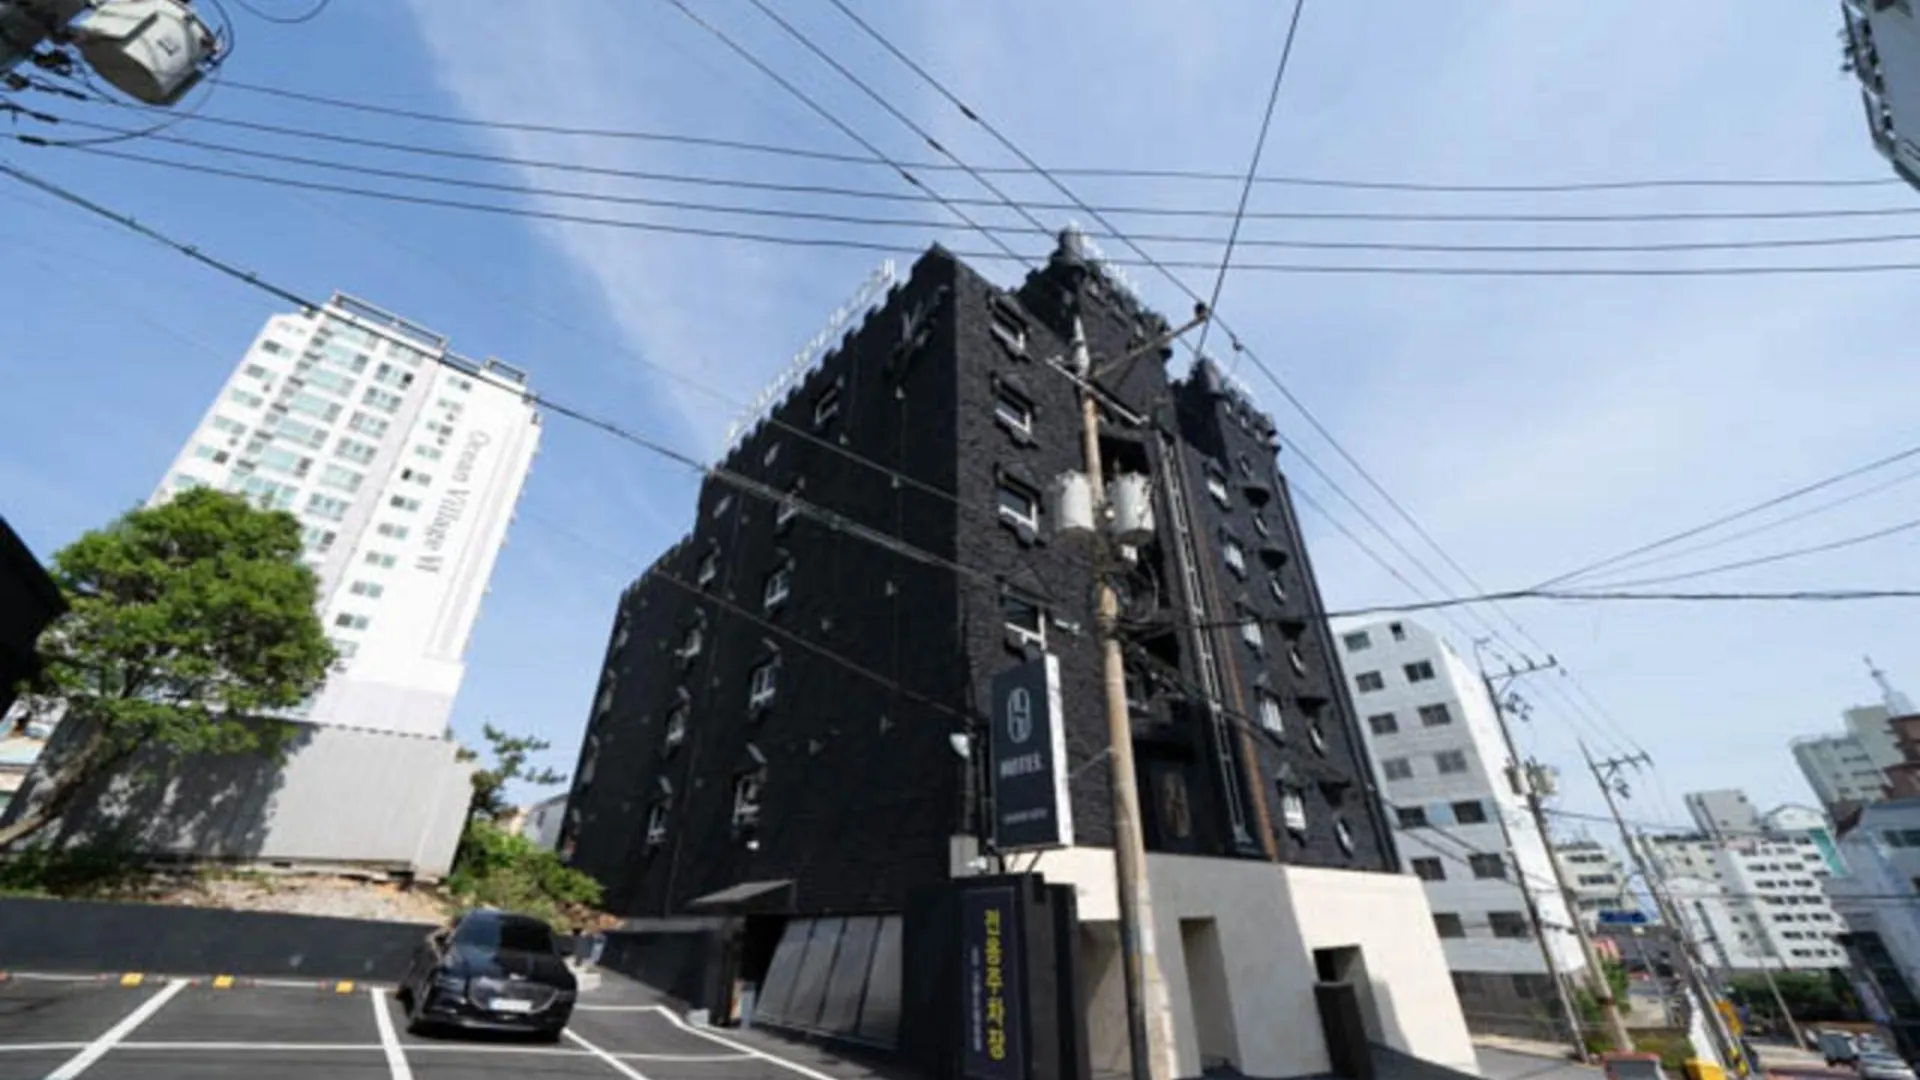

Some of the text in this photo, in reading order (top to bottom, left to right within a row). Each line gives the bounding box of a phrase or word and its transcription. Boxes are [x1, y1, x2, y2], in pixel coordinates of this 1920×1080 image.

[452, 430, 491, 483] Ocean
[424, 488, 471, 551] Village
[1000, 752, 1043, 778] HOTEL
